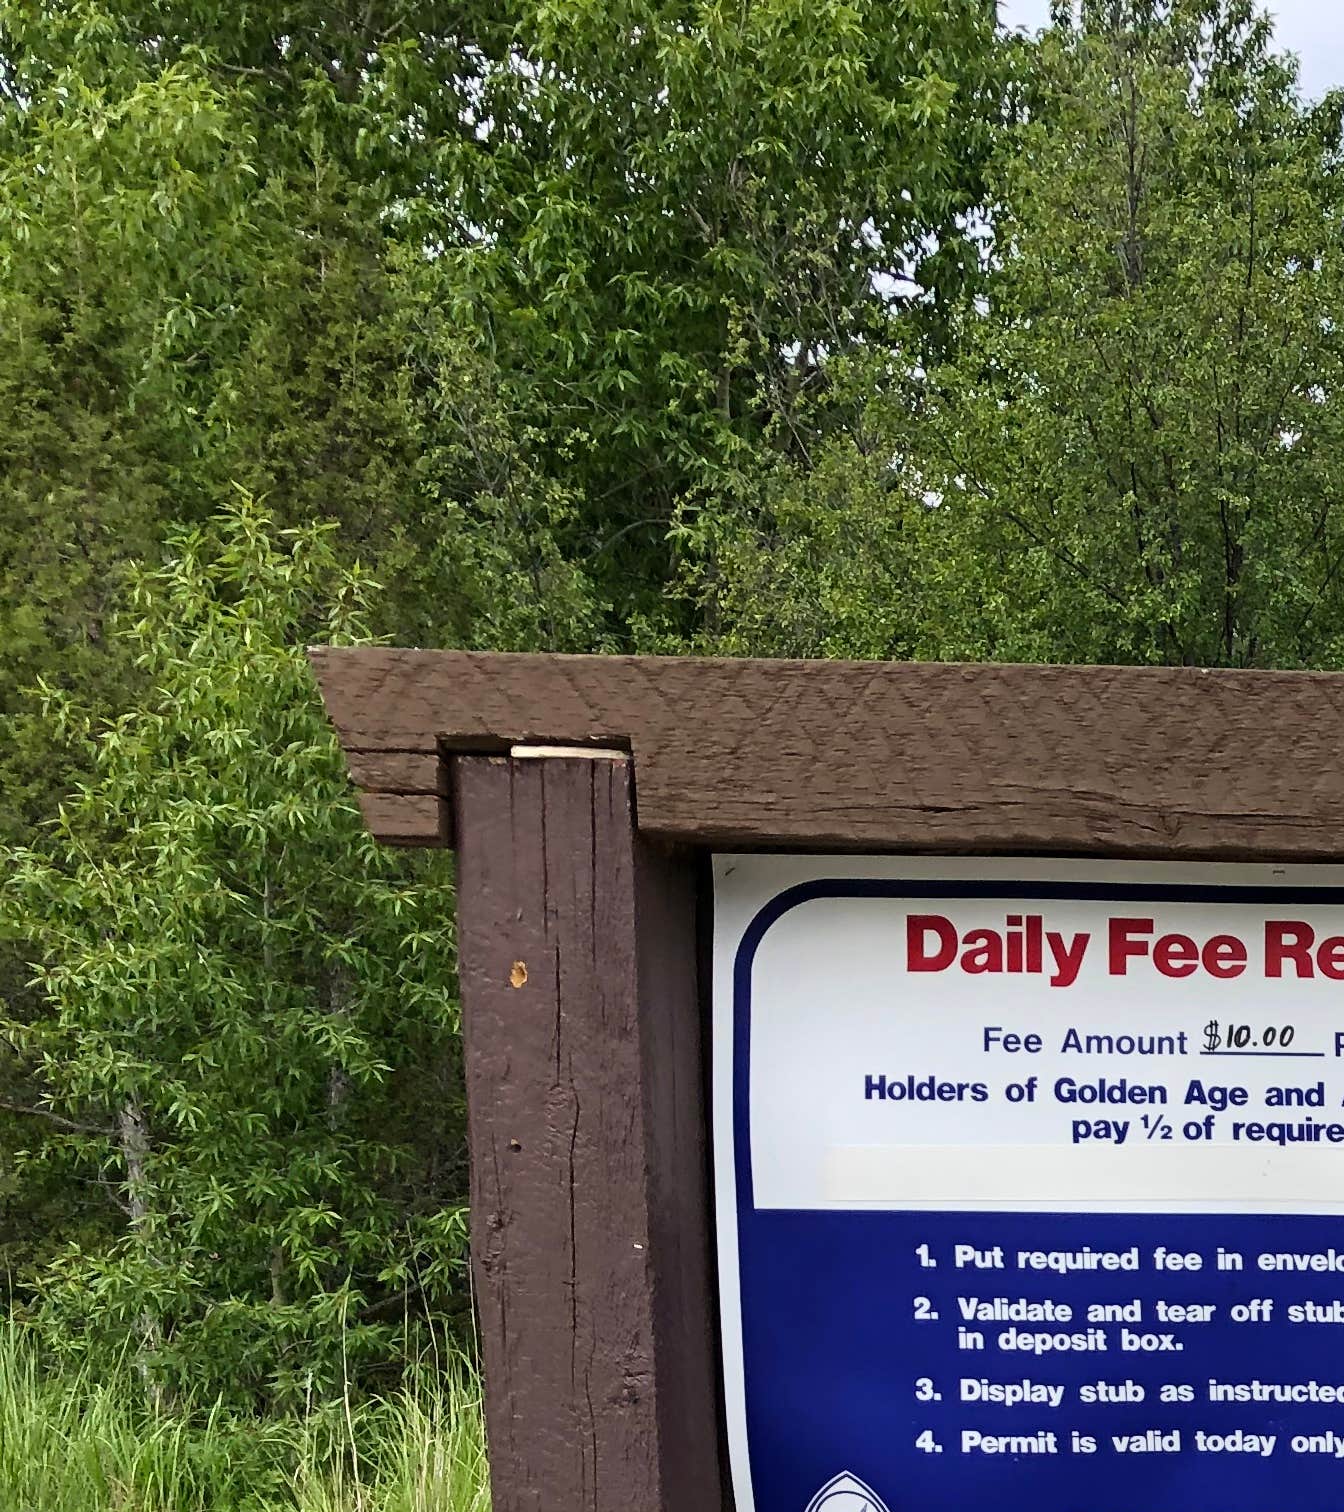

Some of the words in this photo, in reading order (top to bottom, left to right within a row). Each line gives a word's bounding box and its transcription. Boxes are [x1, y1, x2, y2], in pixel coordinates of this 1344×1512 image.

[907, 915, 1090, 986] Daily
[1109, 918, 1247, 978] Fee
[984, 1027, 1042, 1053] Fee
[1061, 1028, 1187, 1054] Amount
[1204, 1020, 1294, 1051] $10.00
[865, 1075, 988, 1101] Holders
[1006, 1077, 1037, 1102] of
[1054, 1078, 1167, 1104] Golden
[1184, 1080, 1248, 1111] Age
[1265, 1082, 1324, 1106] and
[1072, 1120, 1130, 1144] pay
[1183, 1115, 1215, 1140] of
[916, 1244, 936, 1266] 1.
[955, 1245, 1004, 1268] Put
[1018, 1247, 1138, 1273] required
[1154, 1247, 1202, 1270] fee
[1217, 1248, 1242, 1270] in
[914, 1297, 938, 1319] 2.
[958, 1298, 1072, 1322] Validate
[1088, 1300, 1141, 1322] and
[1156, 1301, 1216, 1322] tear
[1231, 1299, 1273, 1321] off
[958, 1327, 984, 1349] in
[998, 1328, 1107, 1354] deposit
[1122, 1329, 1183, 1351] box.
[916, 1378, 941, 1400] 3.
[960, 1379, 1064, 1406] Display
[1080, 1380, 1144, 1402] stub
[1159, 1384, 1195, 1403] as
[916, 1430, 942, 1452] 4.
[962, 1431, 1057, 1453] Permit
[1072, 1431, 1096, 1452] is
[1112, 1430, 1180, 1452] valid
[1195, 1430, 1276, 1456] today
